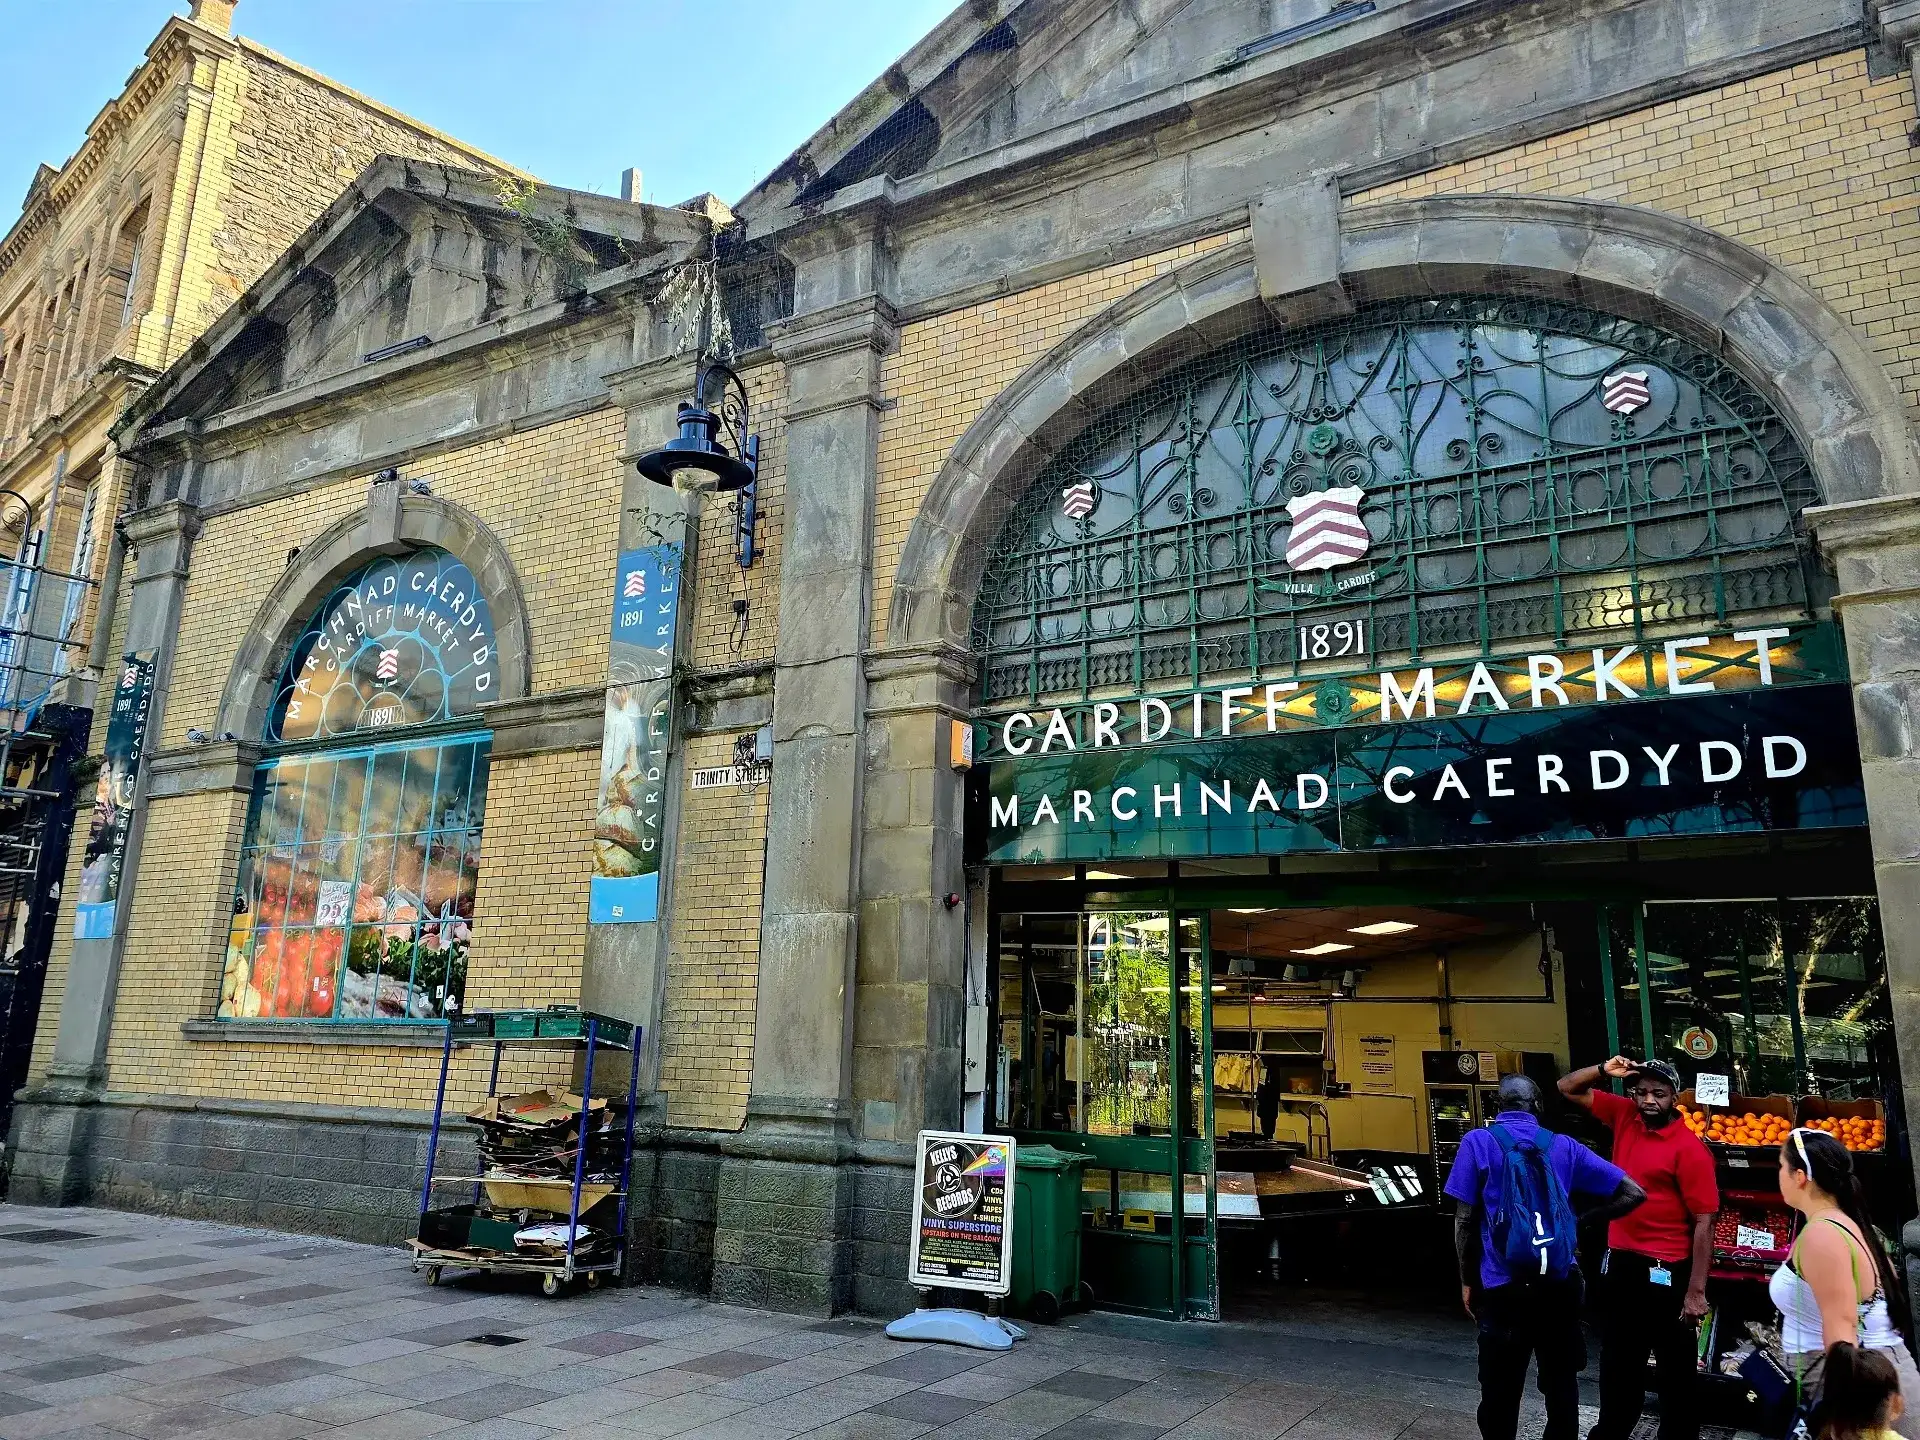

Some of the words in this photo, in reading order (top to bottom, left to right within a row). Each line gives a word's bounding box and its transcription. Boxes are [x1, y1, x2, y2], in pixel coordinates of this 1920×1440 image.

[1285, 584, 1313, 594] VILLA
[1337, 571, 1376, 590] CARDIFF
[620, 609, 644, 628] 1891
[287, 576, 396, 719] MARCHNAD
[411, 572, 491, 692] CAERDYDD
[326, 605, 394, 672] CARDIFF
[403, 602, 459, 652] MARKET
[1300, 619, 1365, 660] 1891
[1002, 681, 1299, 756] CARDIFF
[1380, 627, 1790, 722] MARKET
[116, 698, 132, 711] 1891
[371, 707, 393, 727] 1891
[109, 774, 134, 887] MARCHNAD
[131, 663, 154, 760] CAERDYDD
[642, 708, 665, 853] CARDIFF
[695, 769, 730, 786] TRINITY
[735, 765, 770, 782] STREET
[991, 773, 1329, 828] MARCHNAD
[1383, 735, 1807, 804] CAERDYDD
[936, 1188, 974, 1212] RECORDS
[982, 1205, 1003, 1213] TAPES
[984, 1196, 1003, 1204] VINYL
[923, 1218, 947, 1229] VINYL
[948, 1220, 1002, 1234] SUPERSTORE
[973, 1214, 1002, 1222] T-SHIRTS
[922, 1229, 950, 1238] UPSTAIRS
[972, 1234, 1001, 1243] BALCONY
